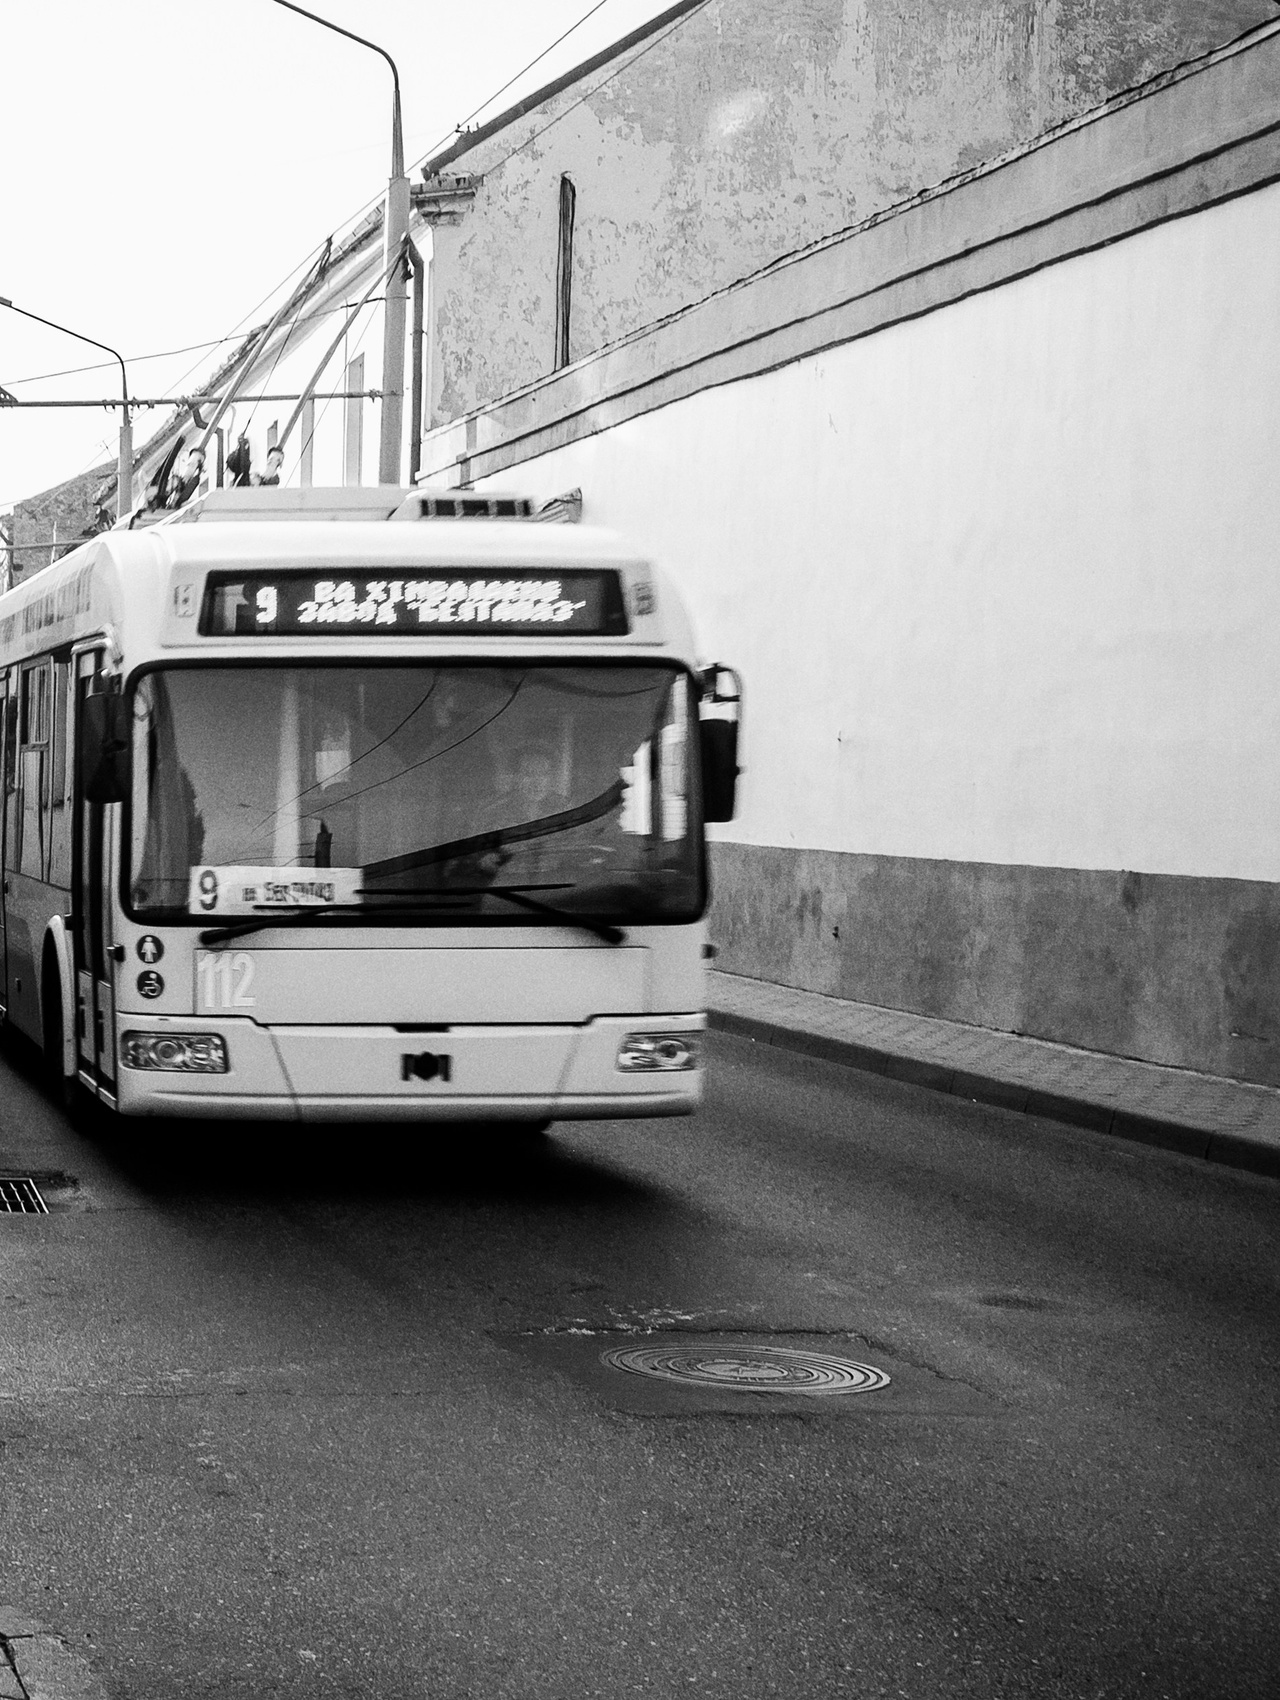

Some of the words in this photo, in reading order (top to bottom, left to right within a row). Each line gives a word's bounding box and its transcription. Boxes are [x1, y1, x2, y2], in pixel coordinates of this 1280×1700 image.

[256, 586, 277, 623] 9
[200, 870, 217, 911] 9
[197, 952, 256, 1008] 112
